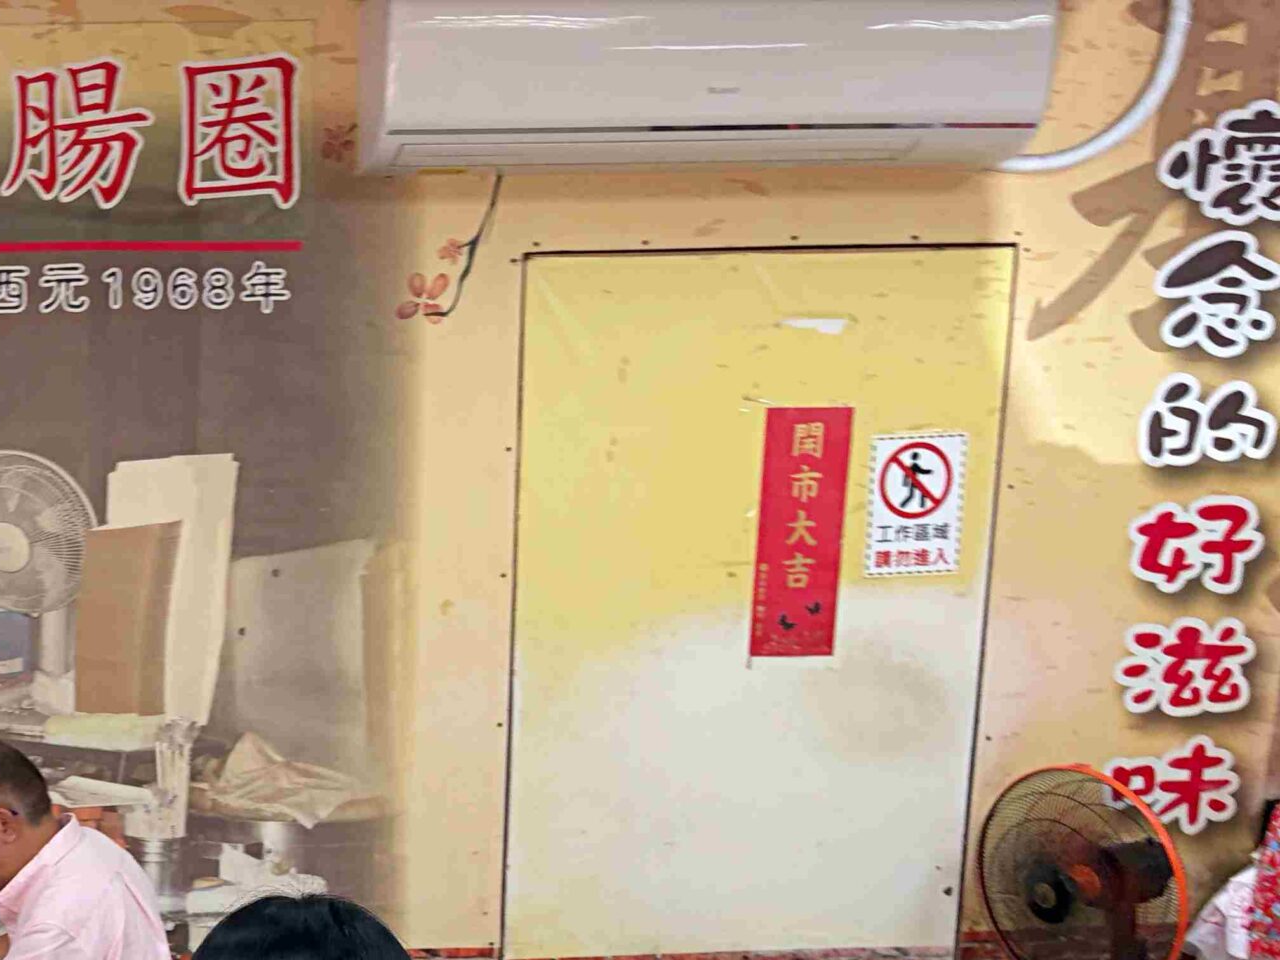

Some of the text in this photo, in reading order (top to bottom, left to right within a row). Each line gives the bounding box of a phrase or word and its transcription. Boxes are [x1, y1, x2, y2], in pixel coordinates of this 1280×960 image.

[782, 421, 825, 589] 開市大吉
[875, 522, 951, 543] 工作區域
[874, 548, 951, 568] 請勿進入
